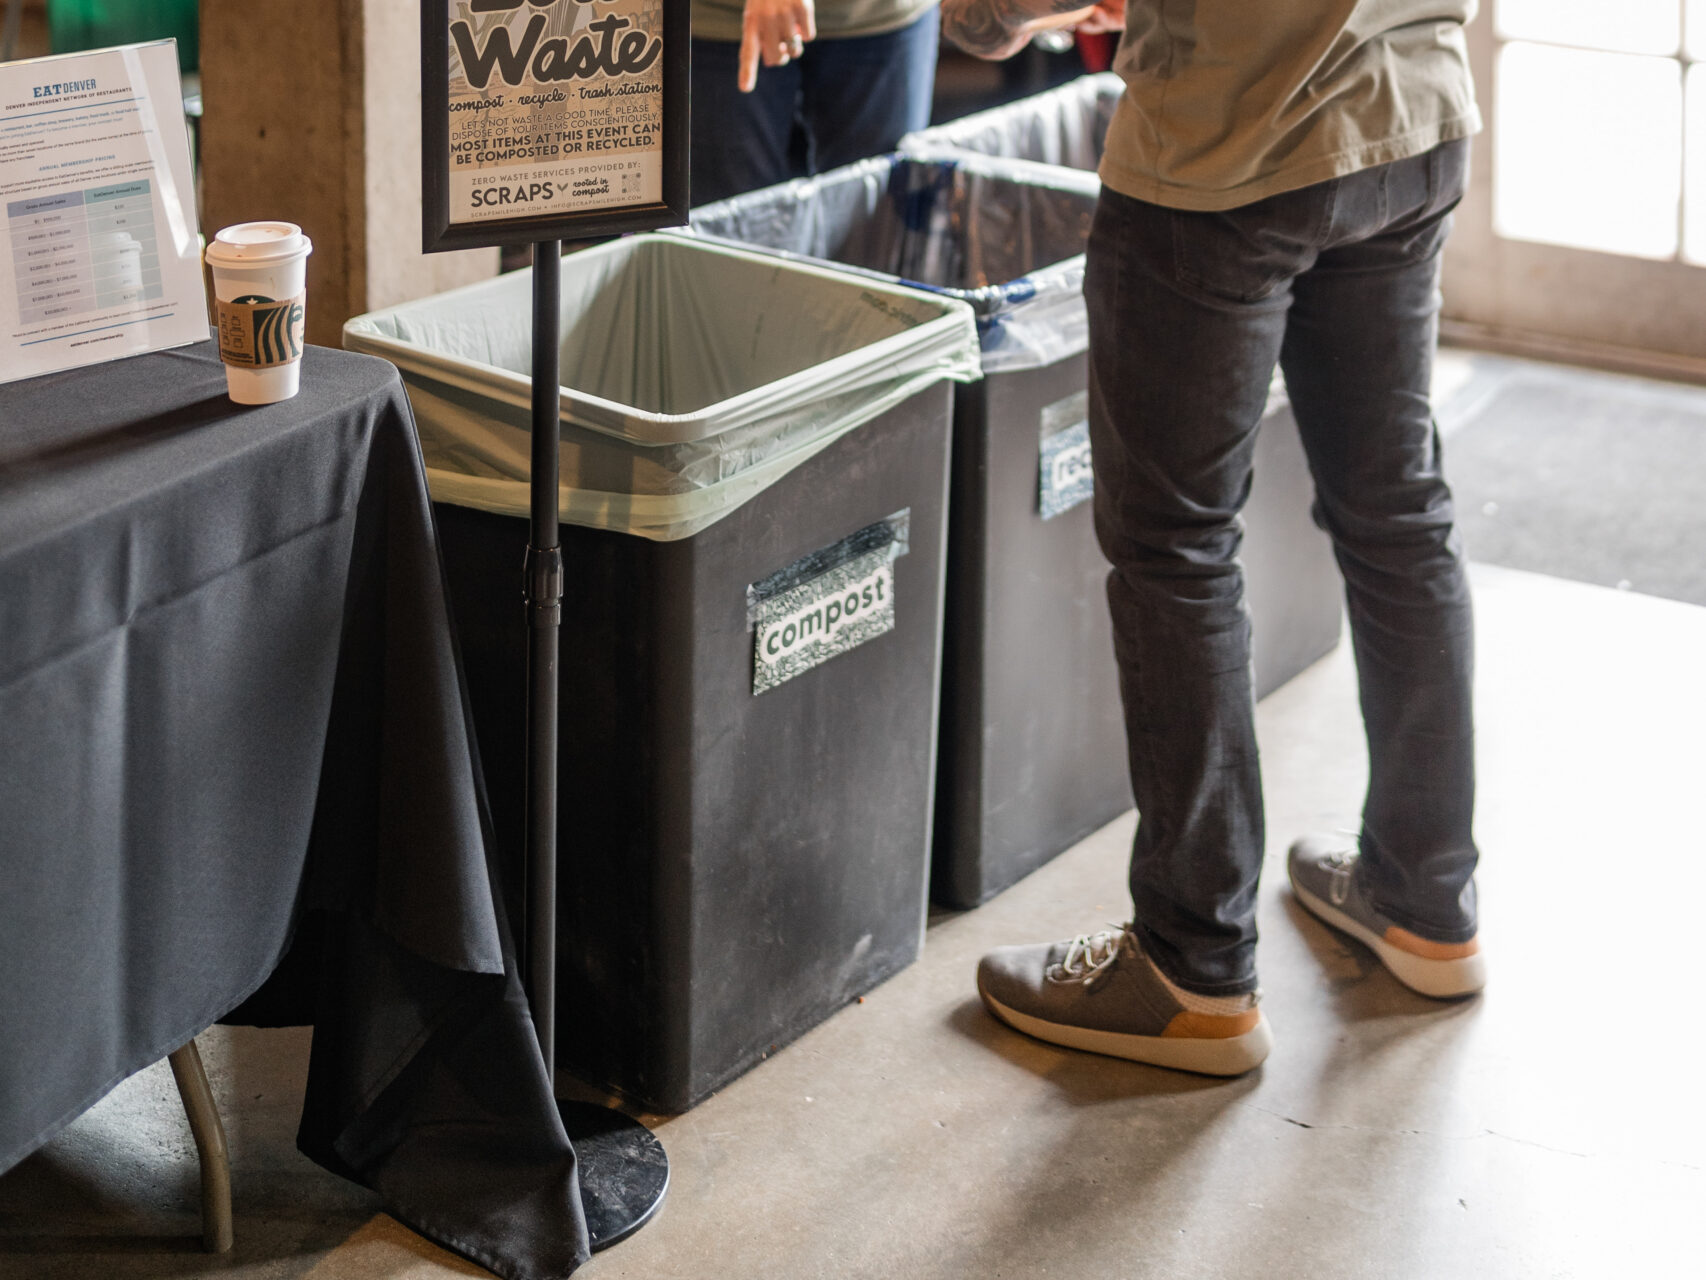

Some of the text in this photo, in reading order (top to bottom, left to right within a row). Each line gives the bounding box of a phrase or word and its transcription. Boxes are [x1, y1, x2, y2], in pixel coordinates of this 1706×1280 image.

[449, 12, 663, 89] Waste
[5, 102, 26, 111] DENVER
[27, 97, 62, 108] INDEPENDENT
[63, 93, 88, 102] NETWORK
[96, 86, 133, 97] RESTAURANTS
[448, 81, 662, 114] compost recycle trash station
[488, 117, 509, 127] NOT
[512, 114, 544, 124] WASTE
[555, 110, 586, 120] GOOD
[616, 104, 649, 114] PLEASE
[450, 122, 661, 153] MOST ITEMS AT THIS EVENT CAN
[452, 129, 493, 140] DISPOSE
[496, 127, 509, 136] OF
[512, 125, 538, 134] YOUR
[540, 121, 569, 131] ITEMS
[456, 135, 655, 165] BE COMPOSTED OR RECYCLED.
[471, 161, 641, 186] ZERO WASTE SERVICES PROVIDED BY:
[572, 177, 609, 188] rooted in
[470, 181, 554, 208] SCRAPS
[572, 184, 610, 197] compost
[765, 574, 885, 656] compost
